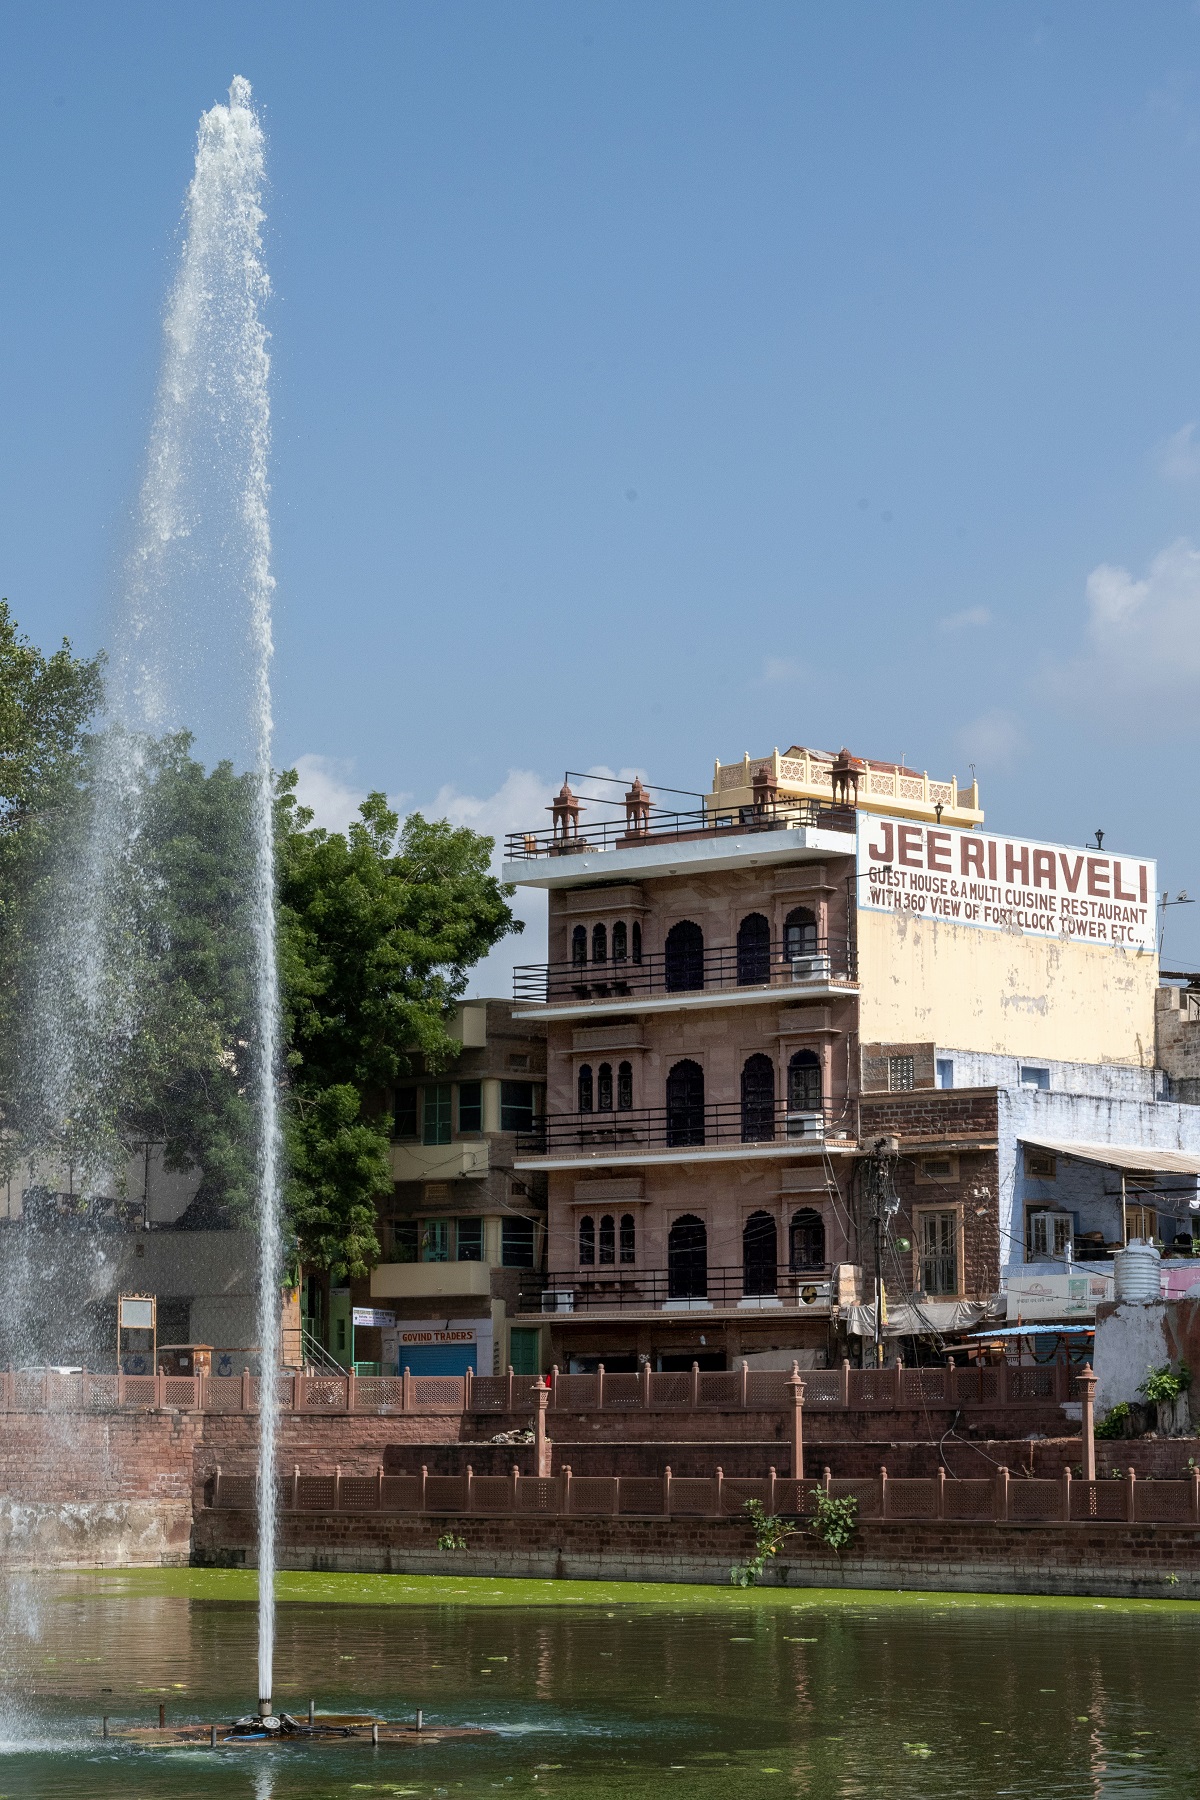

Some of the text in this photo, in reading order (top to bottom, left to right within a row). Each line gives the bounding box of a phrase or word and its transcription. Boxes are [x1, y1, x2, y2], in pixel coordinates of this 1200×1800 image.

[869, 822, 1148, 904] JEE RI HAVELI
[868, 866, 907, 889] GUEST
[910, 873, 948, 895] HOUSE
[950, 880, 959, 897] &
[969, 882, 1001, 904] MULTI
[1005, 889, 1057, 912] CUISINE
[1060, 897, 1148, 925] RESTAURANT
[869, 886, 902, 908] WITH
[930, 896, 961, 917] VIEW
[964, 902, 979, 921] OF
[984, 906, 1013, 926] FORT
[1017, 910, 1055, 932] CLOCK
[1059, 915, 1107, 939] TOWER
[402, 1331, 473, 1342] GOVIND TRADERS
